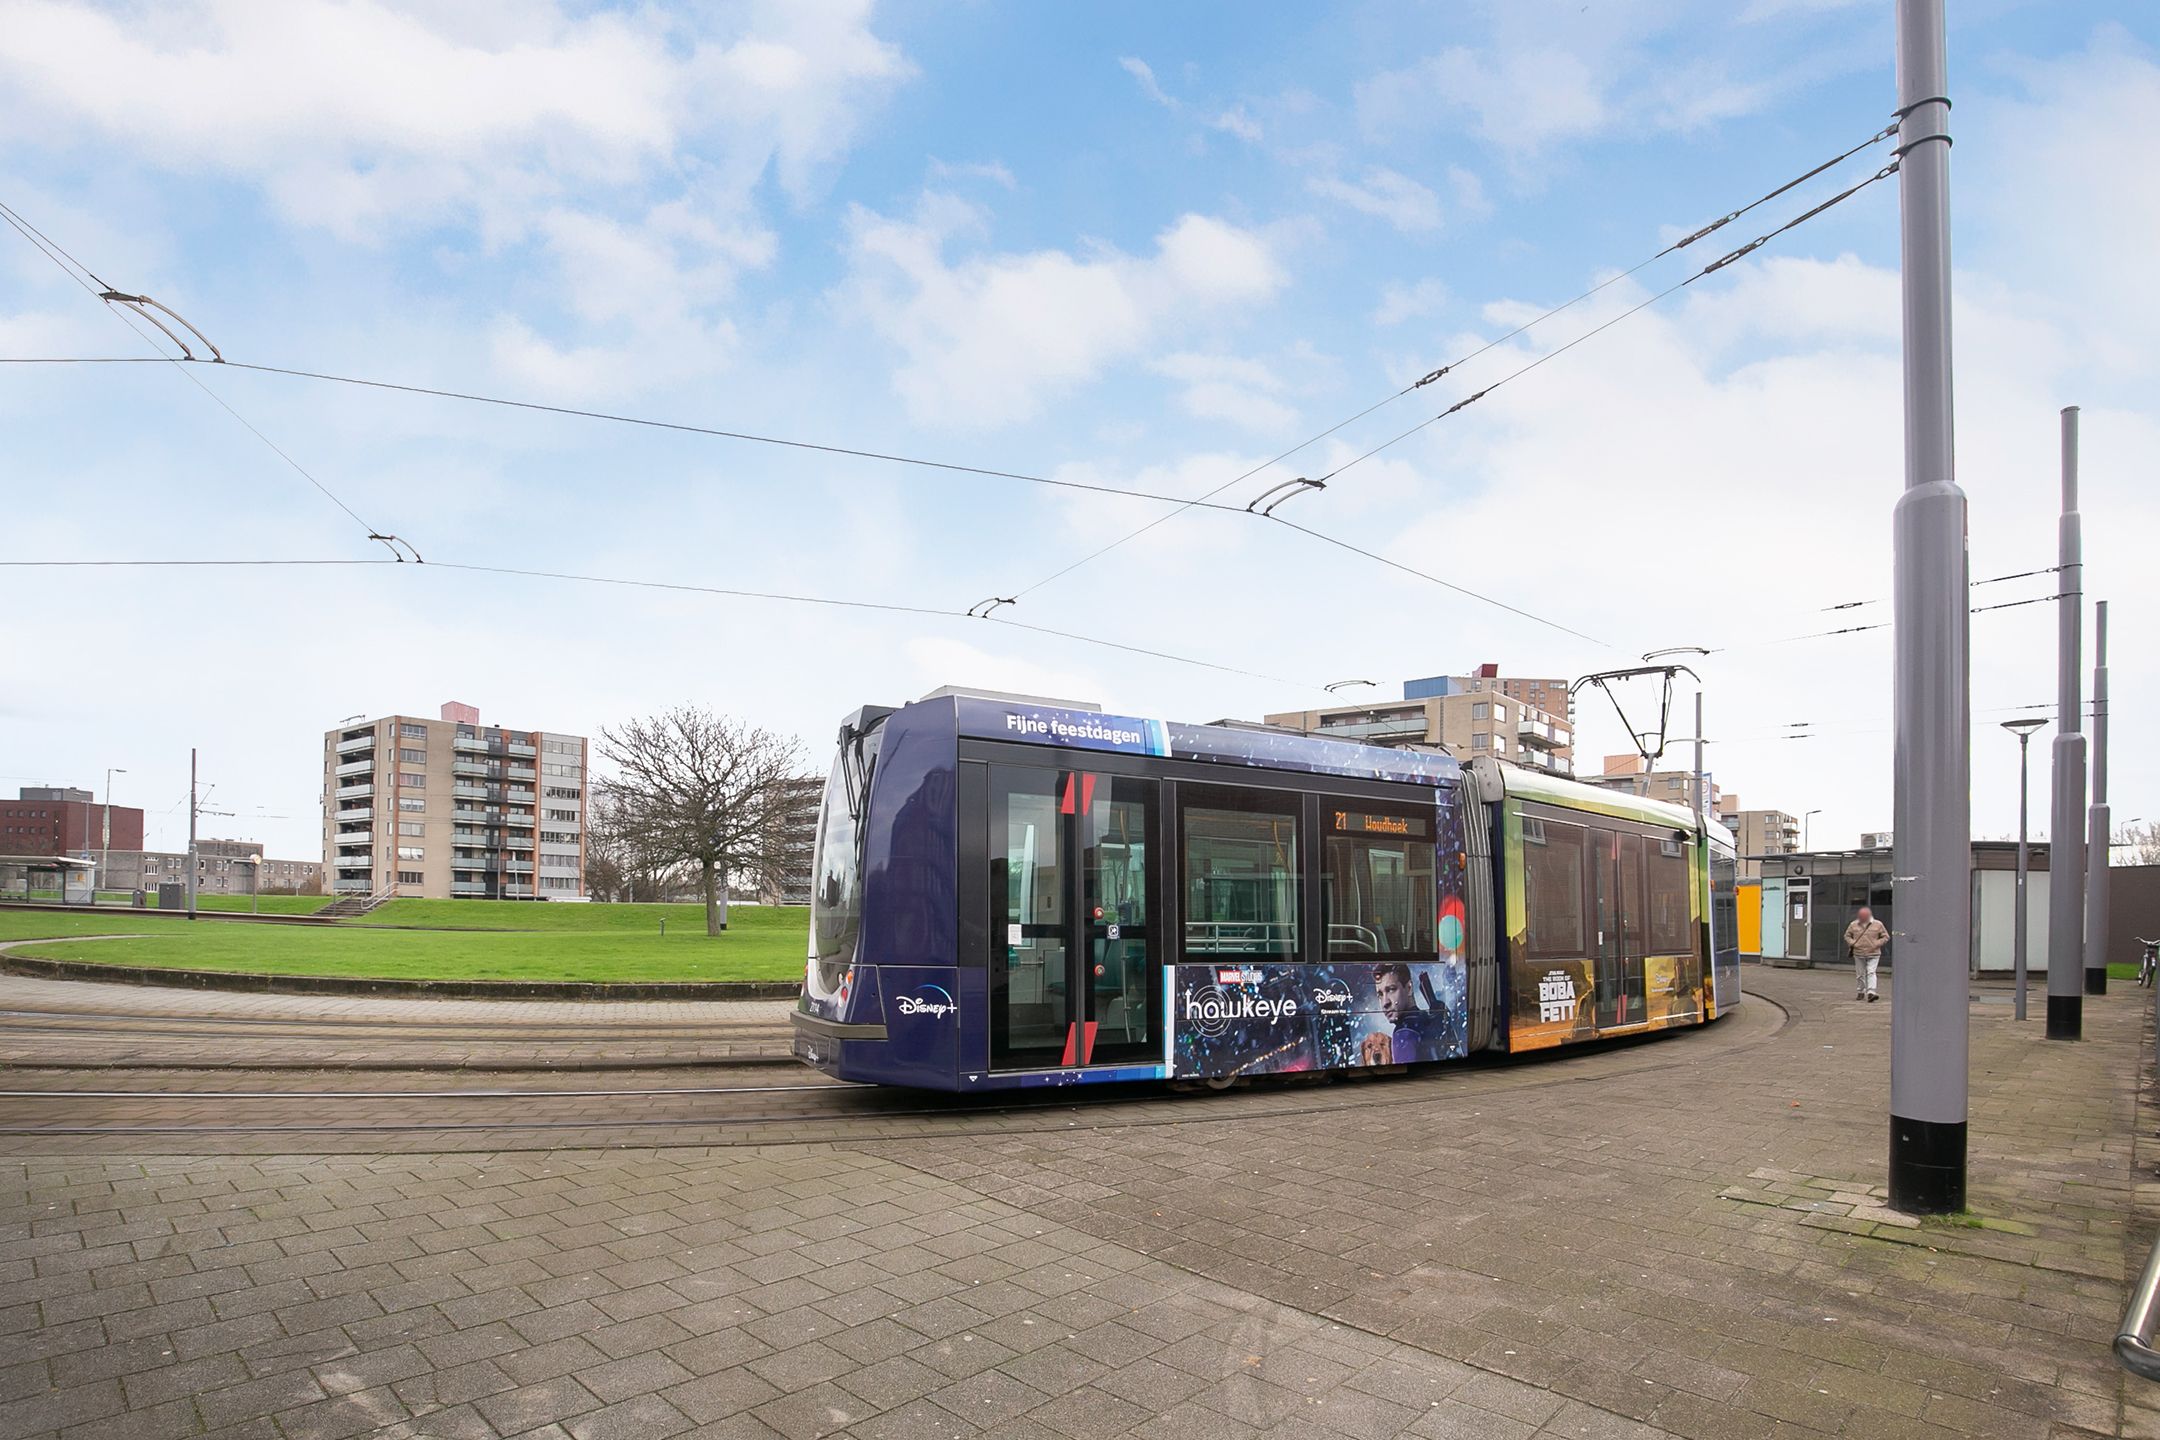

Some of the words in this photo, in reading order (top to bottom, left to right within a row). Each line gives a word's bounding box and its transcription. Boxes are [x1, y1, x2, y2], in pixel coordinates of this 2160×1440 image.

[1006, 714, 1047, 734] Fijne
[1051, 720, 1141, 744] feestdagen
[1335, 811, 1347, 830] 21
[1220, 971, 1240, 983] MARVEL
[1538, 981, 1575, 1001] BOBA
[1186, 988, 1297, 1025] hawkeye
[1539, 1000, 1576, 1023] FETT
